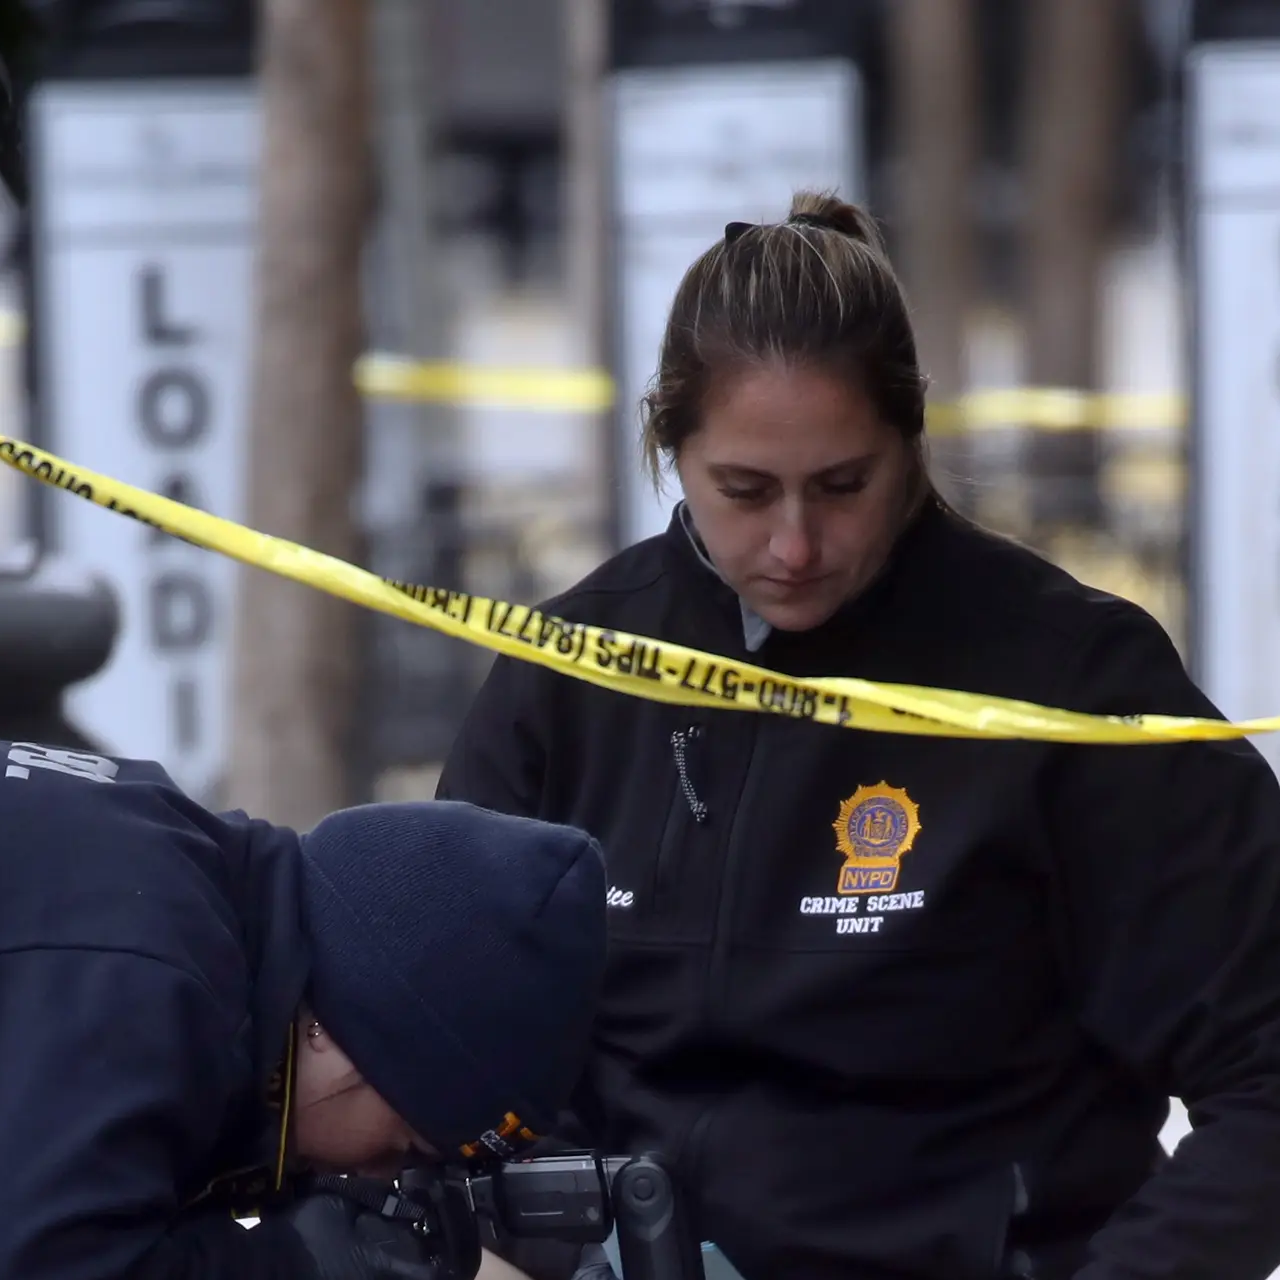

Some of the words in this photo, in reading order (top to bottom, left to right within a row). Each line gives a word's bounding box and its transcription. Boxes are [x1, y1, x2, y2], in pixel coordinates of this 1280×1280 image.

[843, 870, 894, 888] NYPD
[799, 896, 860, 914] CRIME
[866, 890, 925, 912] SCENE
[836, 916, 884, 934] UNIT
